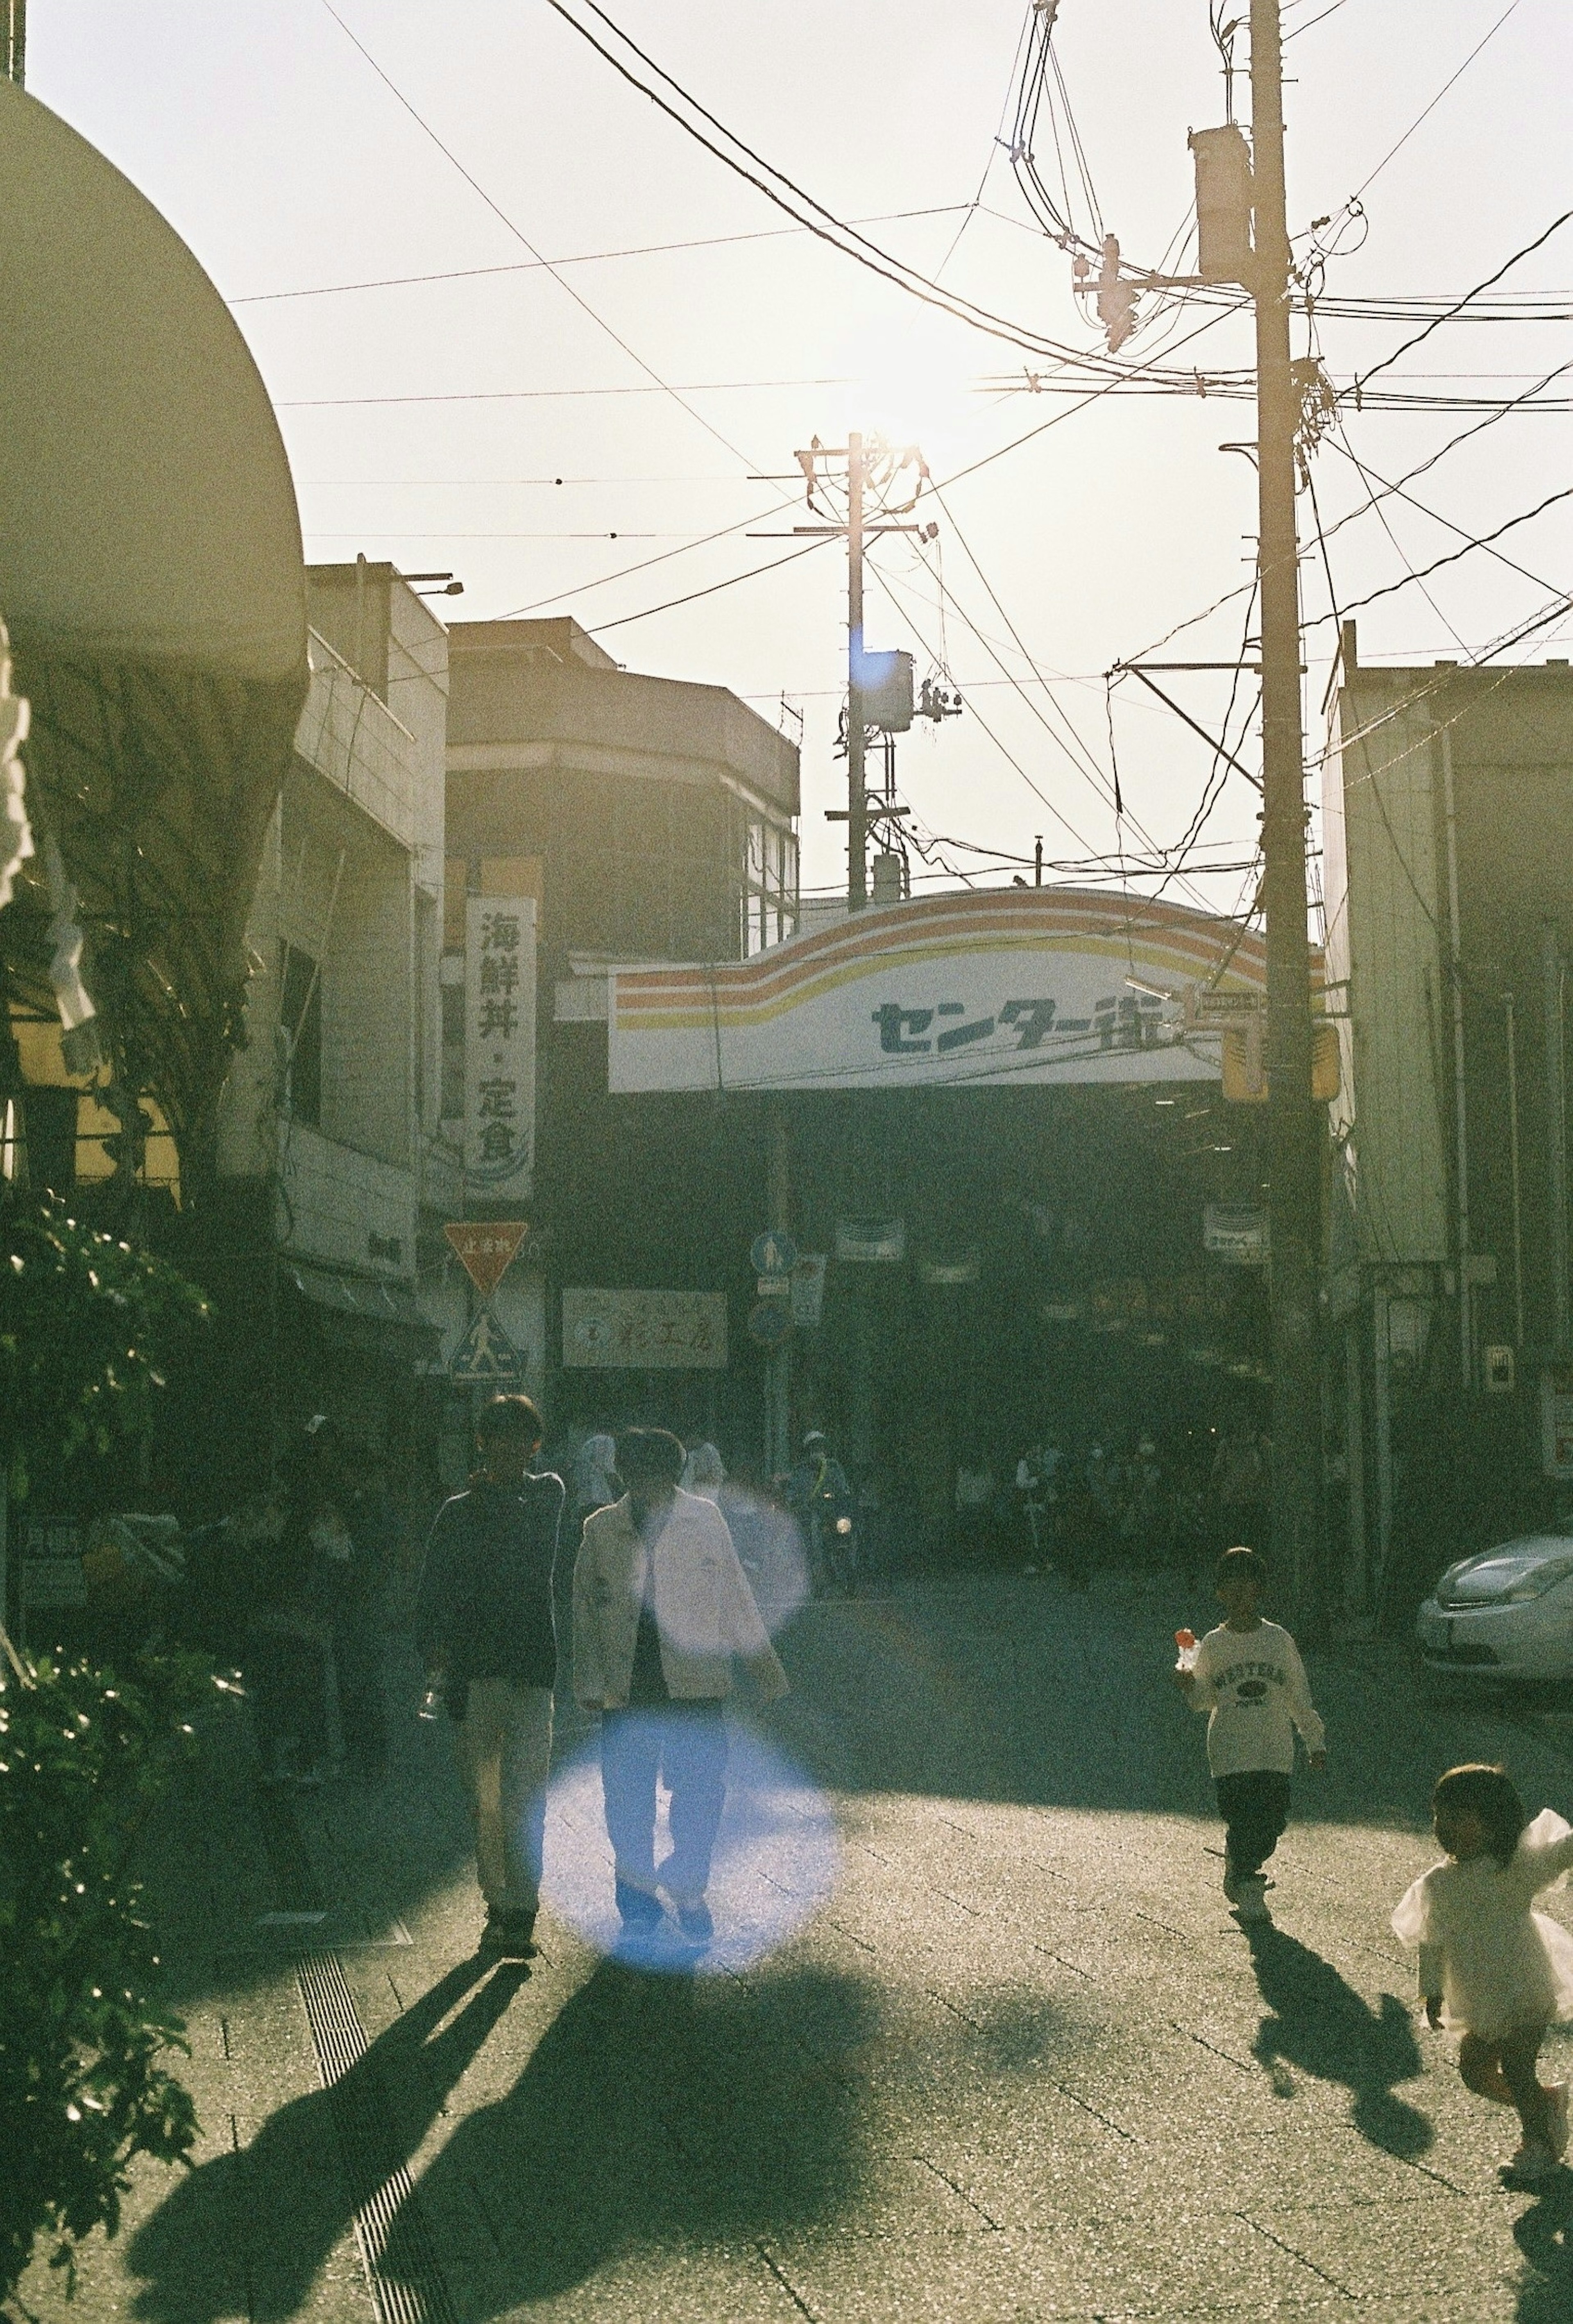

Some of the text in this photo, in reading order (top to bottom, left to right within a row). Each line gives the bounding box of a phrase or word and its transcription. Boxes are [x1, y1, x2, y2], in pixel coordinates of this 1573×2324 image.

[479, 912, 521, 1161] 海鮮丼・定食
[872, 996, 1164, 1053] センター街
[462, 1237, 512, 1254] 止まれ
